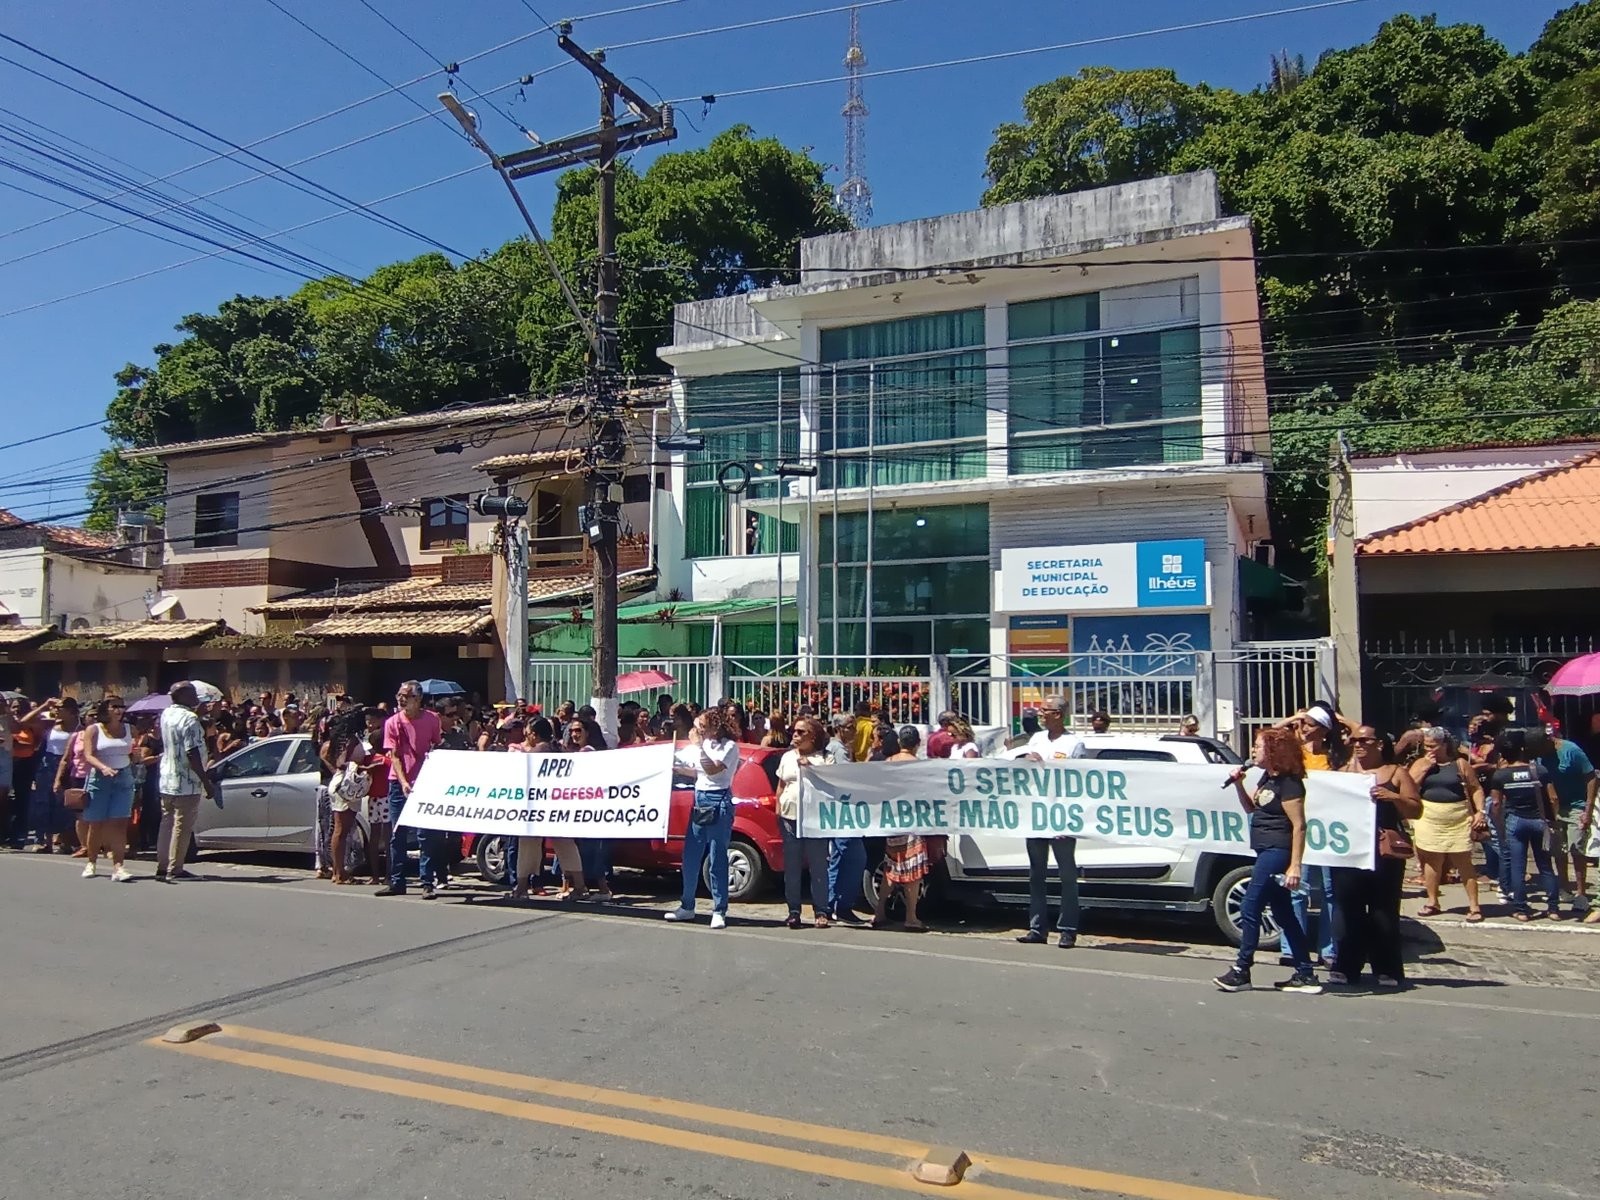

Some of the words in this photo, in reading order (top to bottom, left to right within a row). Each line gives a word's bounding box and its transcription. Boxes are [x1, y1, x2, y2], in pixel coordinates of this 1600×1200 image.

[1027, 558, 1103, 570] SECRETARIA
[1031, 572, 1098, 582] MUNICIPAL
[1148, 576, 1197, 590] Ilhéus
[1022, 587, 1038, 597] DE
[1041, 583, 1109, 597] EDUCAÇÃO
[948, 768, 966, 795] O
[976, 768, 1128, 801] SERVIDOR
[445, 784, 481, 798] APPI
[487, 786, 525, 800] APLB
[528, 787, 547, 801] EM
[551, 787, 604, 800] DEFESA
[608, 785, 641, 799] DOS
[416, 802, 545, 823] TRABALHADORES
[548, 809, 570, 823] EM
[573, 805, 659, 826] EDUCAÇÃO
[818, 793, 871, 830] NÃO
[880, 799, 948, 829] ABRE
[959, 795, 1019, 829] MÃO
[1032, 802, 1084, 832] DOS
[1095, 805, 1175, 837] SEUS
[1186, 808, 1351, 855] DIROS
